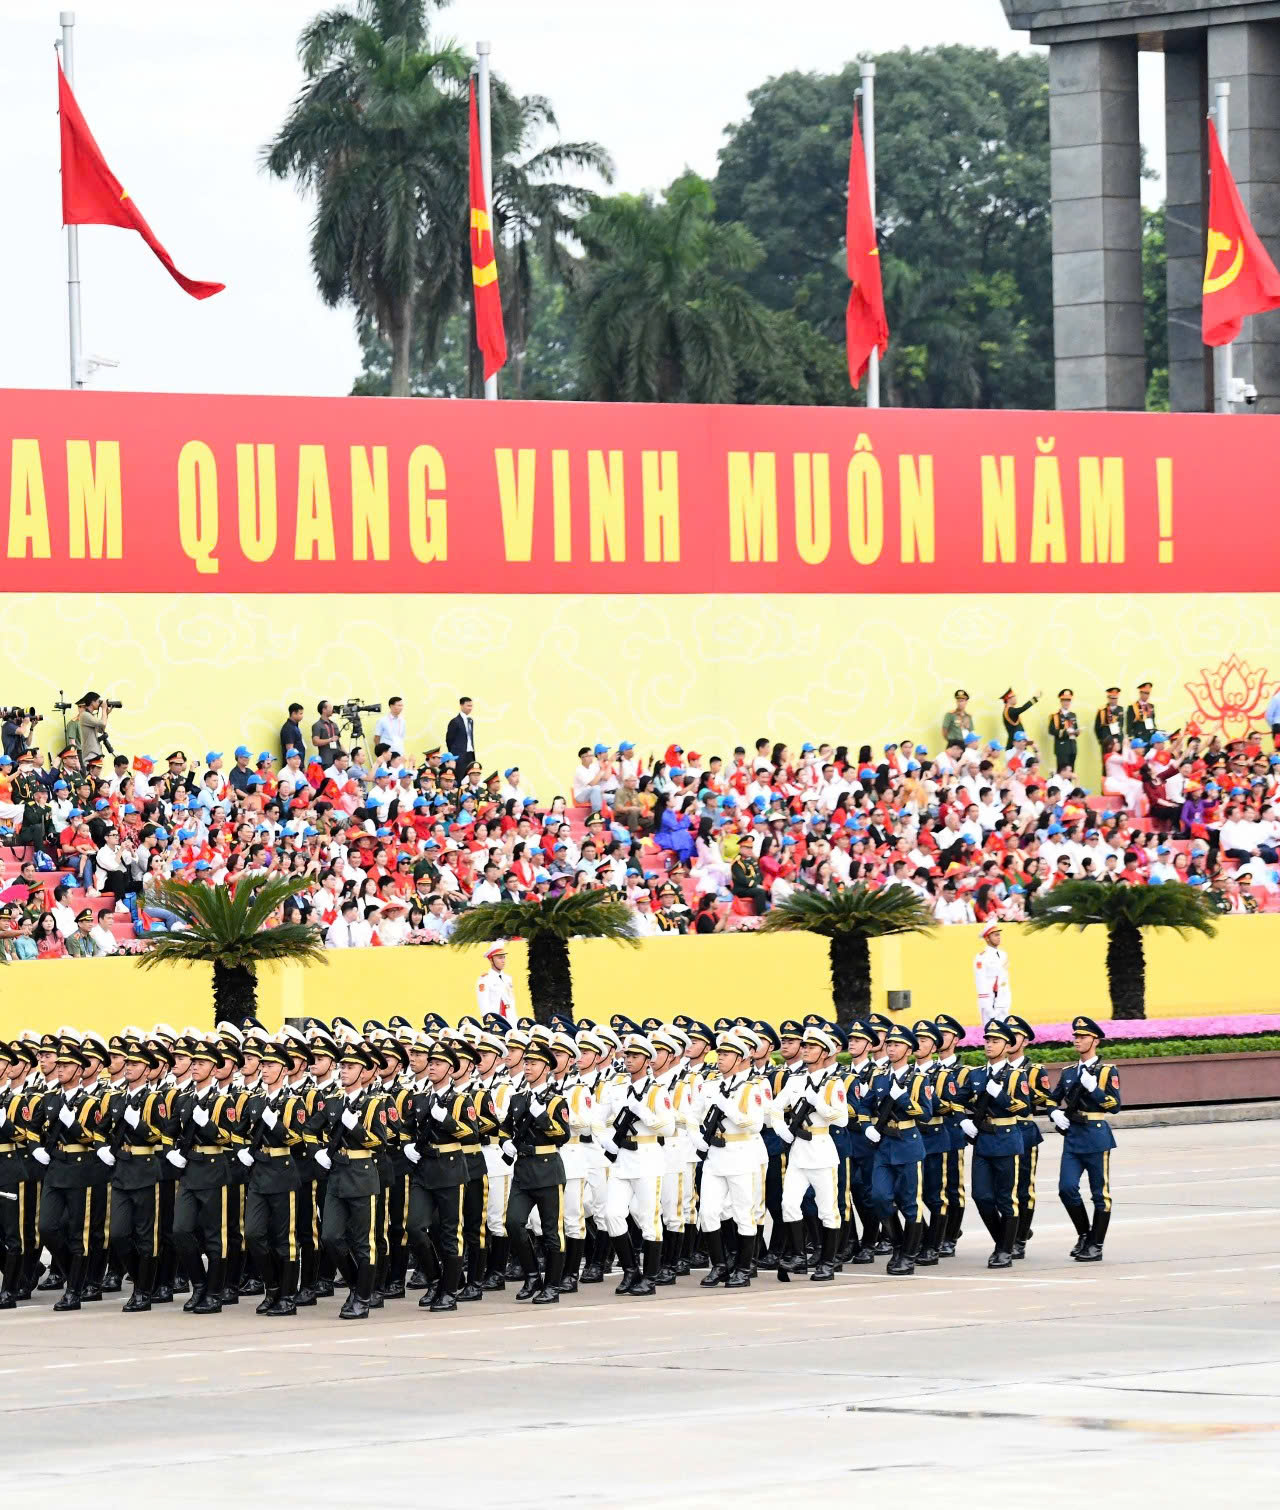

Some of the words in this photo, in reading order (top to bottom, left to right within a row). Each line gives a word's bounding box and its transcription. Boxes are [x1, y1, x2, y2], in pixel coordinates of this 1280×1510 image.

[178, 440, 448, 574] QUANG
[495, 448, 681, 562] VINH
[728, 433, 935, 564] MUÔN
[981, 436, 1125, 563] NĂM
